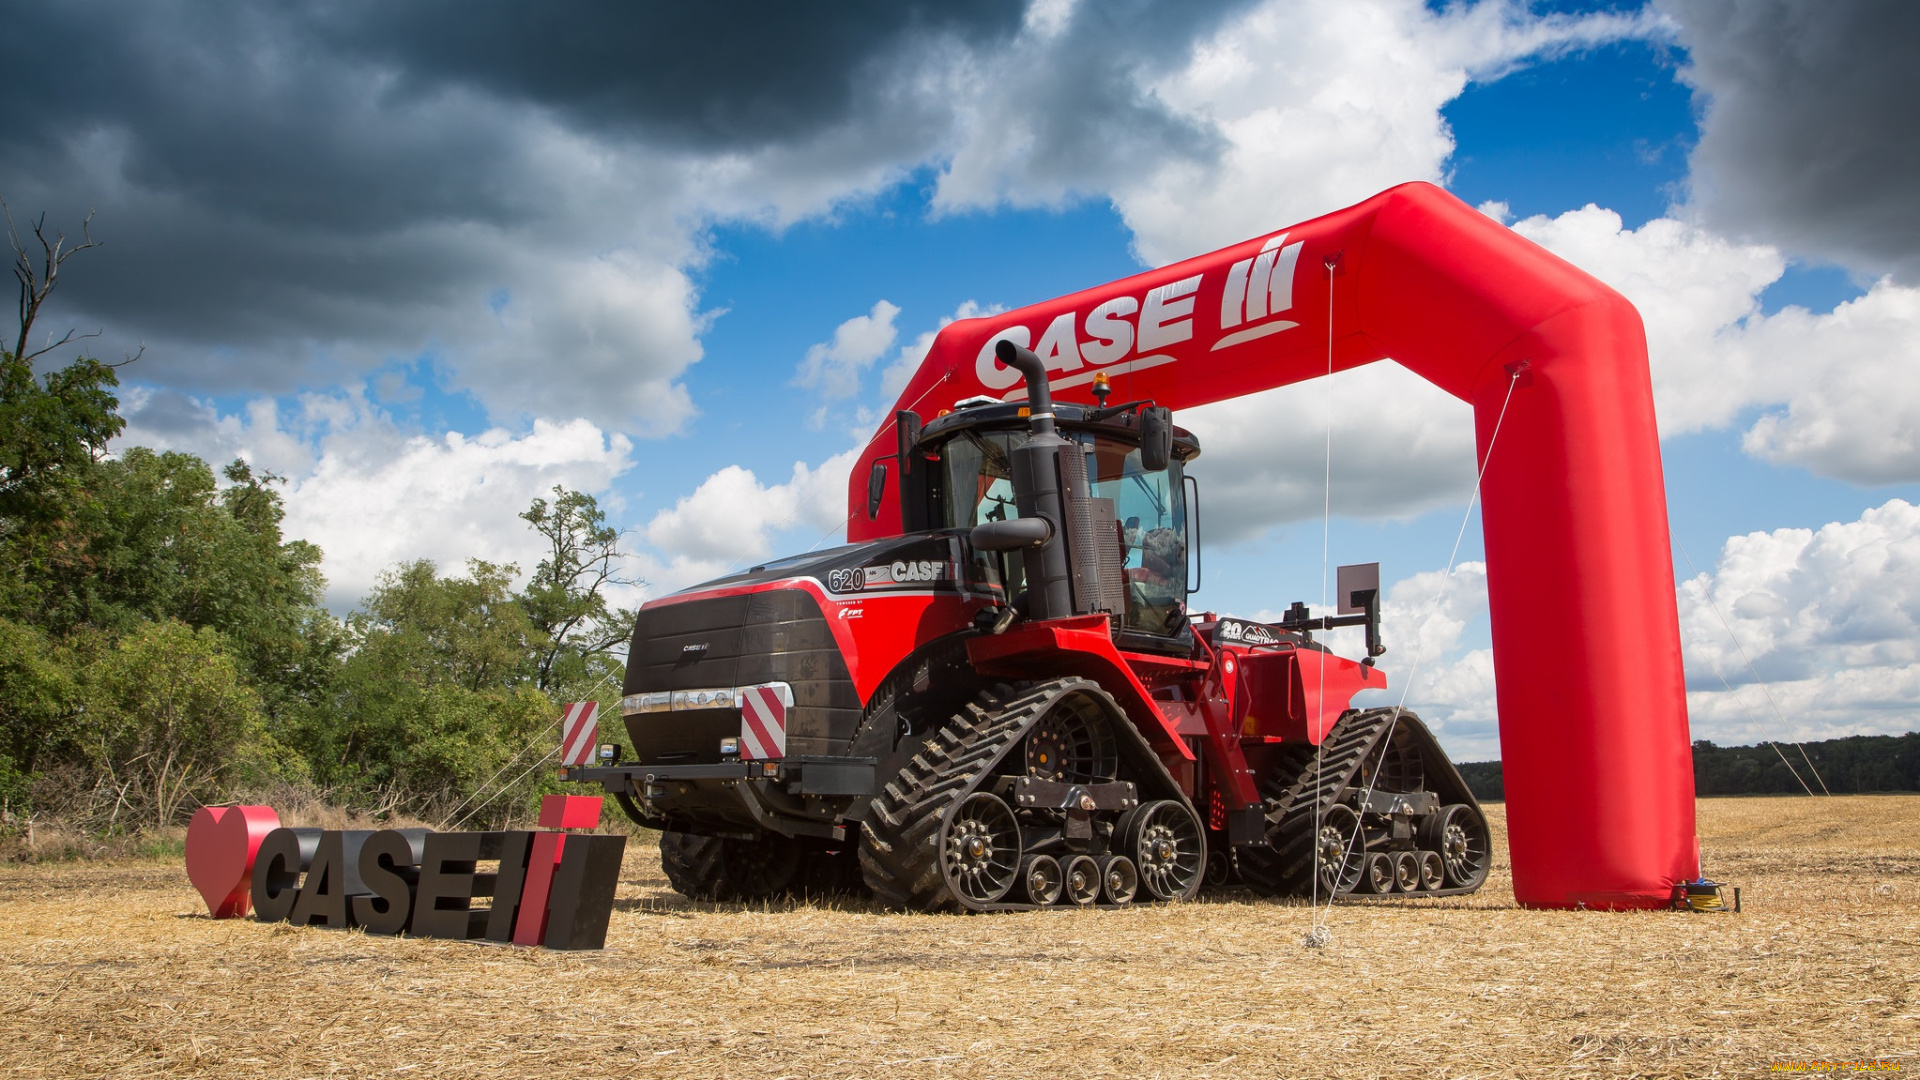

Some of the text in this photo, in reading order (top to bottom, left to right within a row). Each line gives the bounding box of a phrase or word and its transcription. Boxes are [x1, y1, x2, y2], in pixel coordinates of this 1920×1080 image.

[975, 273, 1204, 390] CASE
[828, 568, 865, 592] 620
[890, 561, 943, 582] CASE
[1220, 620, 1242, 638] 20
[250, 828, 482, 940] CASE
